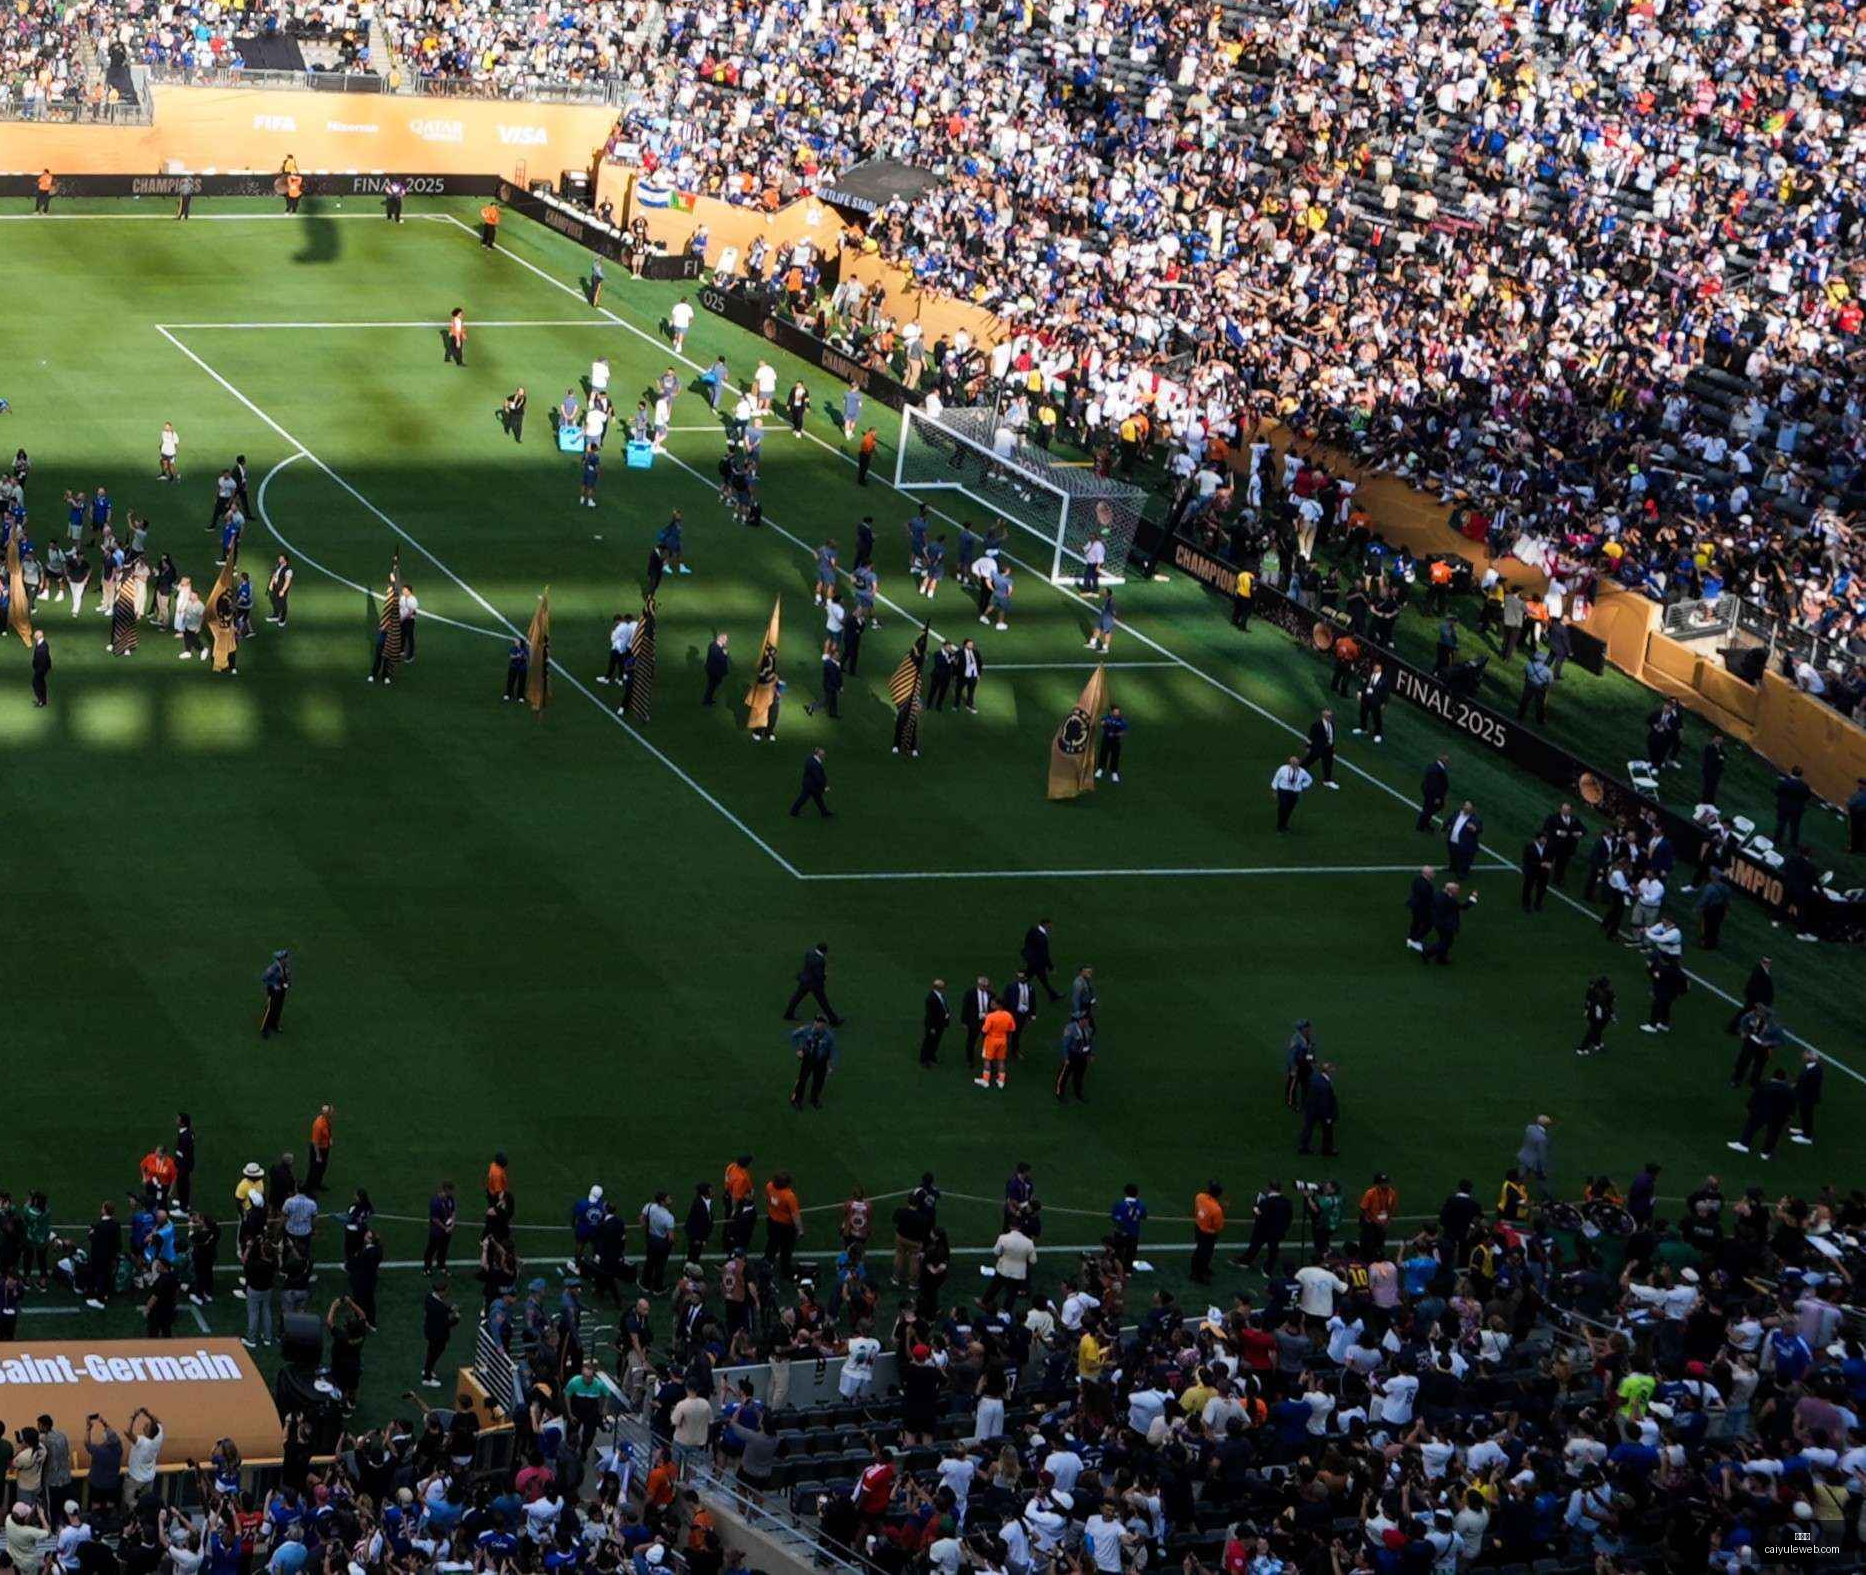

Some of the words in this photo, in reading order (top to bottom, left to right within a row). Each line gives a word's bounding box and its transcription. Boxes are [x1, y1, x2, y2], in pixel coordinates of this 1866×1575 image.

[253, 114, 297, 133] FIFA
[498, 126, 549, 145] VISA
[405, 178, 445, 194] 2025
[1174, 543, 1237, 590] CHAMPION
[1394, 669, 1456, 722] FINAL
[1453, 702, 1507, 749] 2025
